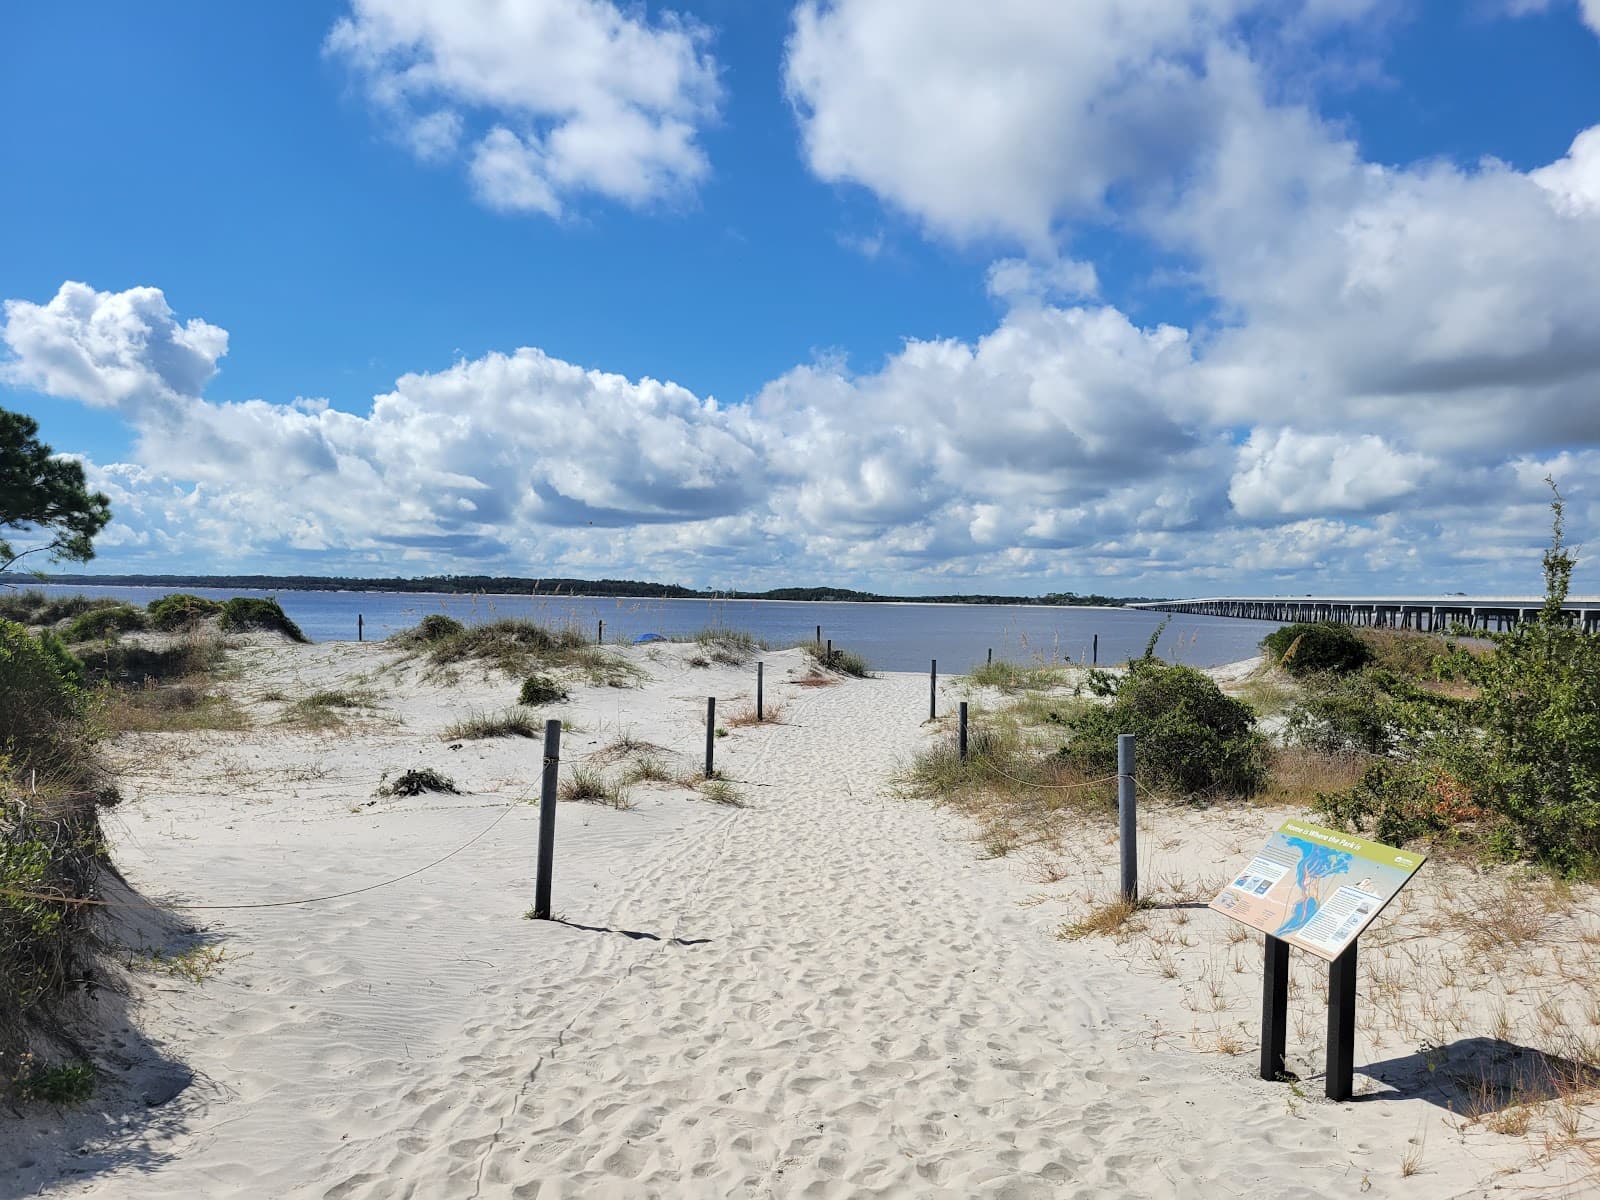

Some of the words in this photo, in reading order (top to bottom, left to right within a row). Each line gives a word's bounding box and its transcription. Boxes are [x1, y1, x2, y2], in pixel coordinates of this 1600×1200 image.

[1309, 830, 1329, 841] Where
[1328, 835, 1340, 844] the
[1339, 839, 1355, 849] Park
